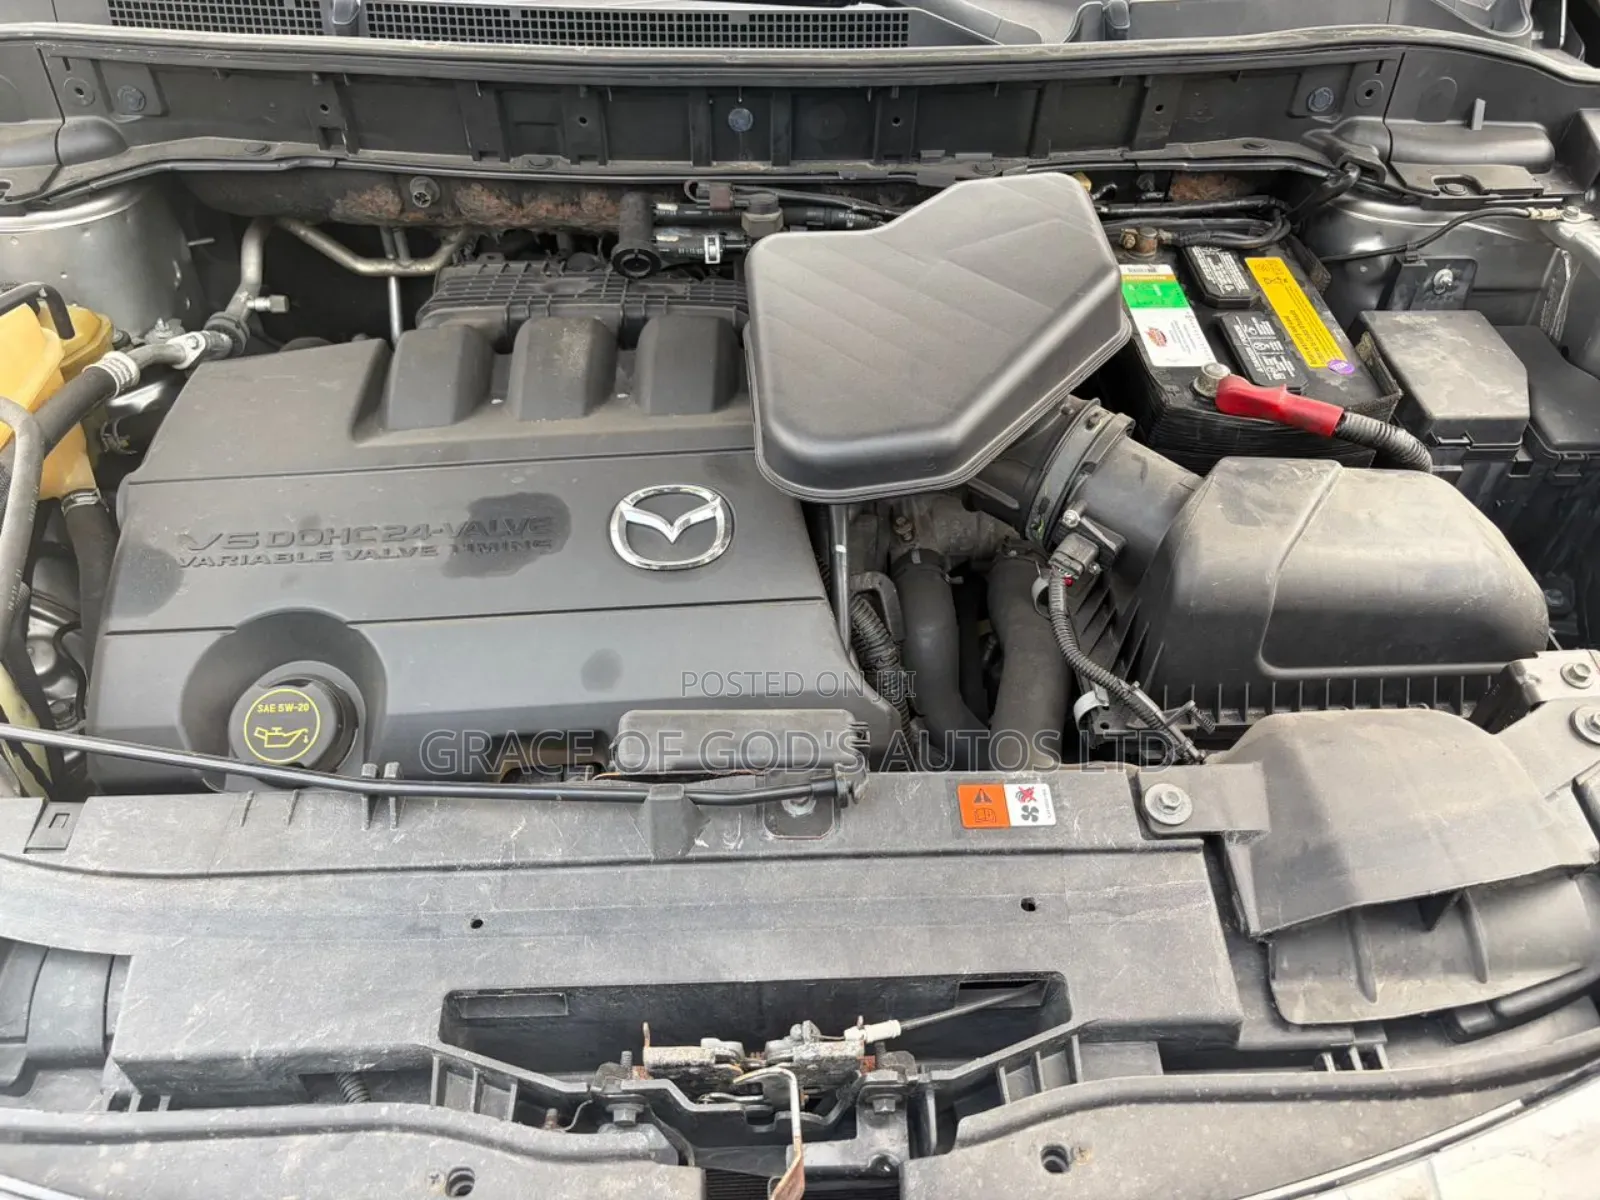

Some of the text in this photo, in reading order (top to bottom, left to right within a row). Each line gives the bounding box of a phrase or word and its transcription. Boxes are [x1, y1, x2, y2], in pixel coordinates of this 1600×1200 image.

[264, 526, 378, 548] DOHC
[179, 550, 334, 568] VARIABLE
[346, 544, 439, 561] VALVE
[257, 702, 310, 714] SAE 5W-20
